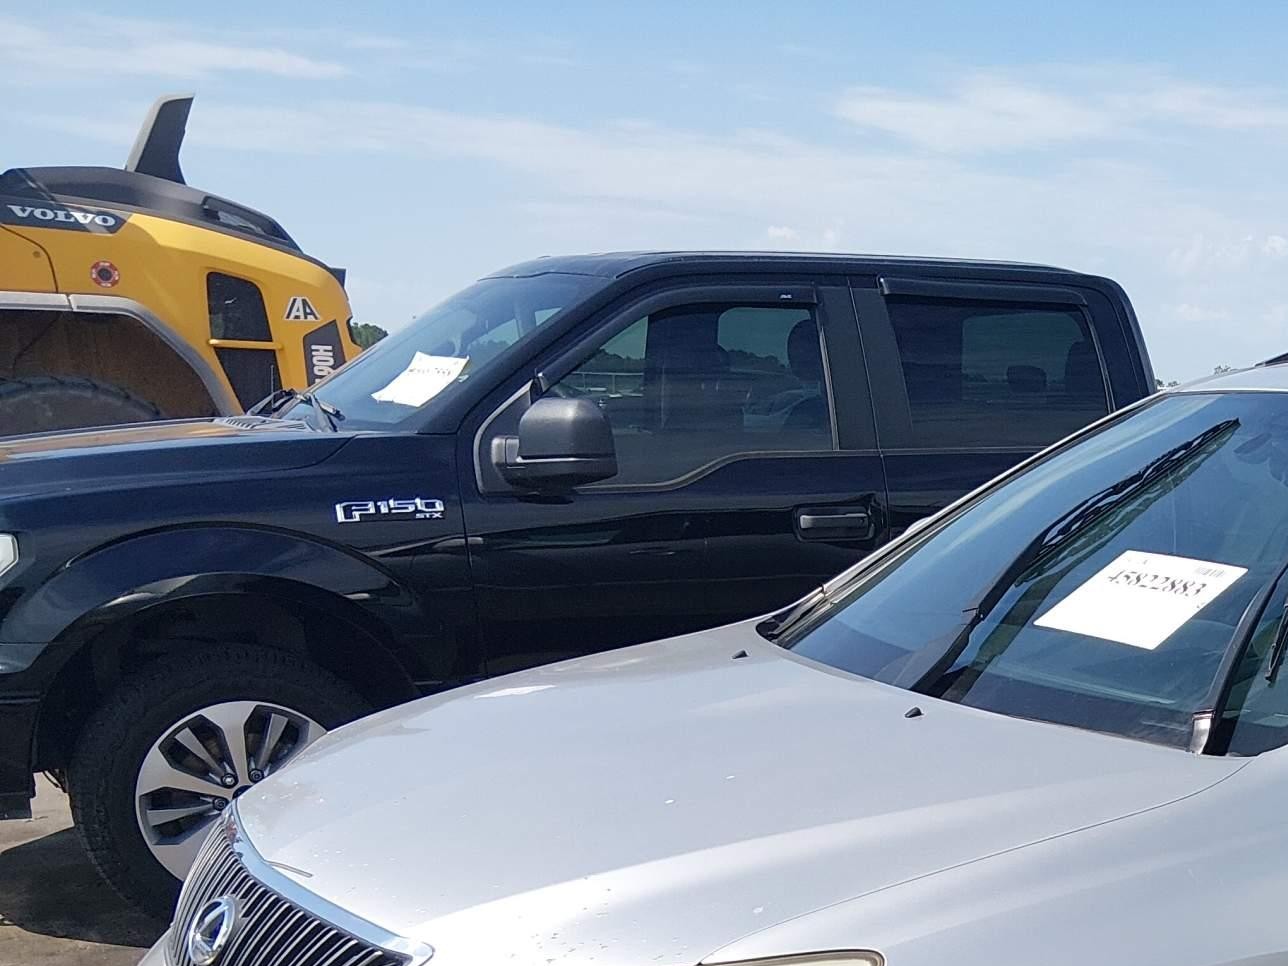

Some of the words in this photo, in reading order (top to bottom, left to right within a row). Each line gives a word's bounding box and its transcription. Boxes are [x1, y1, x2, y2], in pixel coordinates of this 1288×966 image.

[6, 204, 116, 226] VOLVO
[311, 344, 334, 383] 90H
[415, 511, 443, 519] STX
[1107, 569, 1208, 597] 45822883
